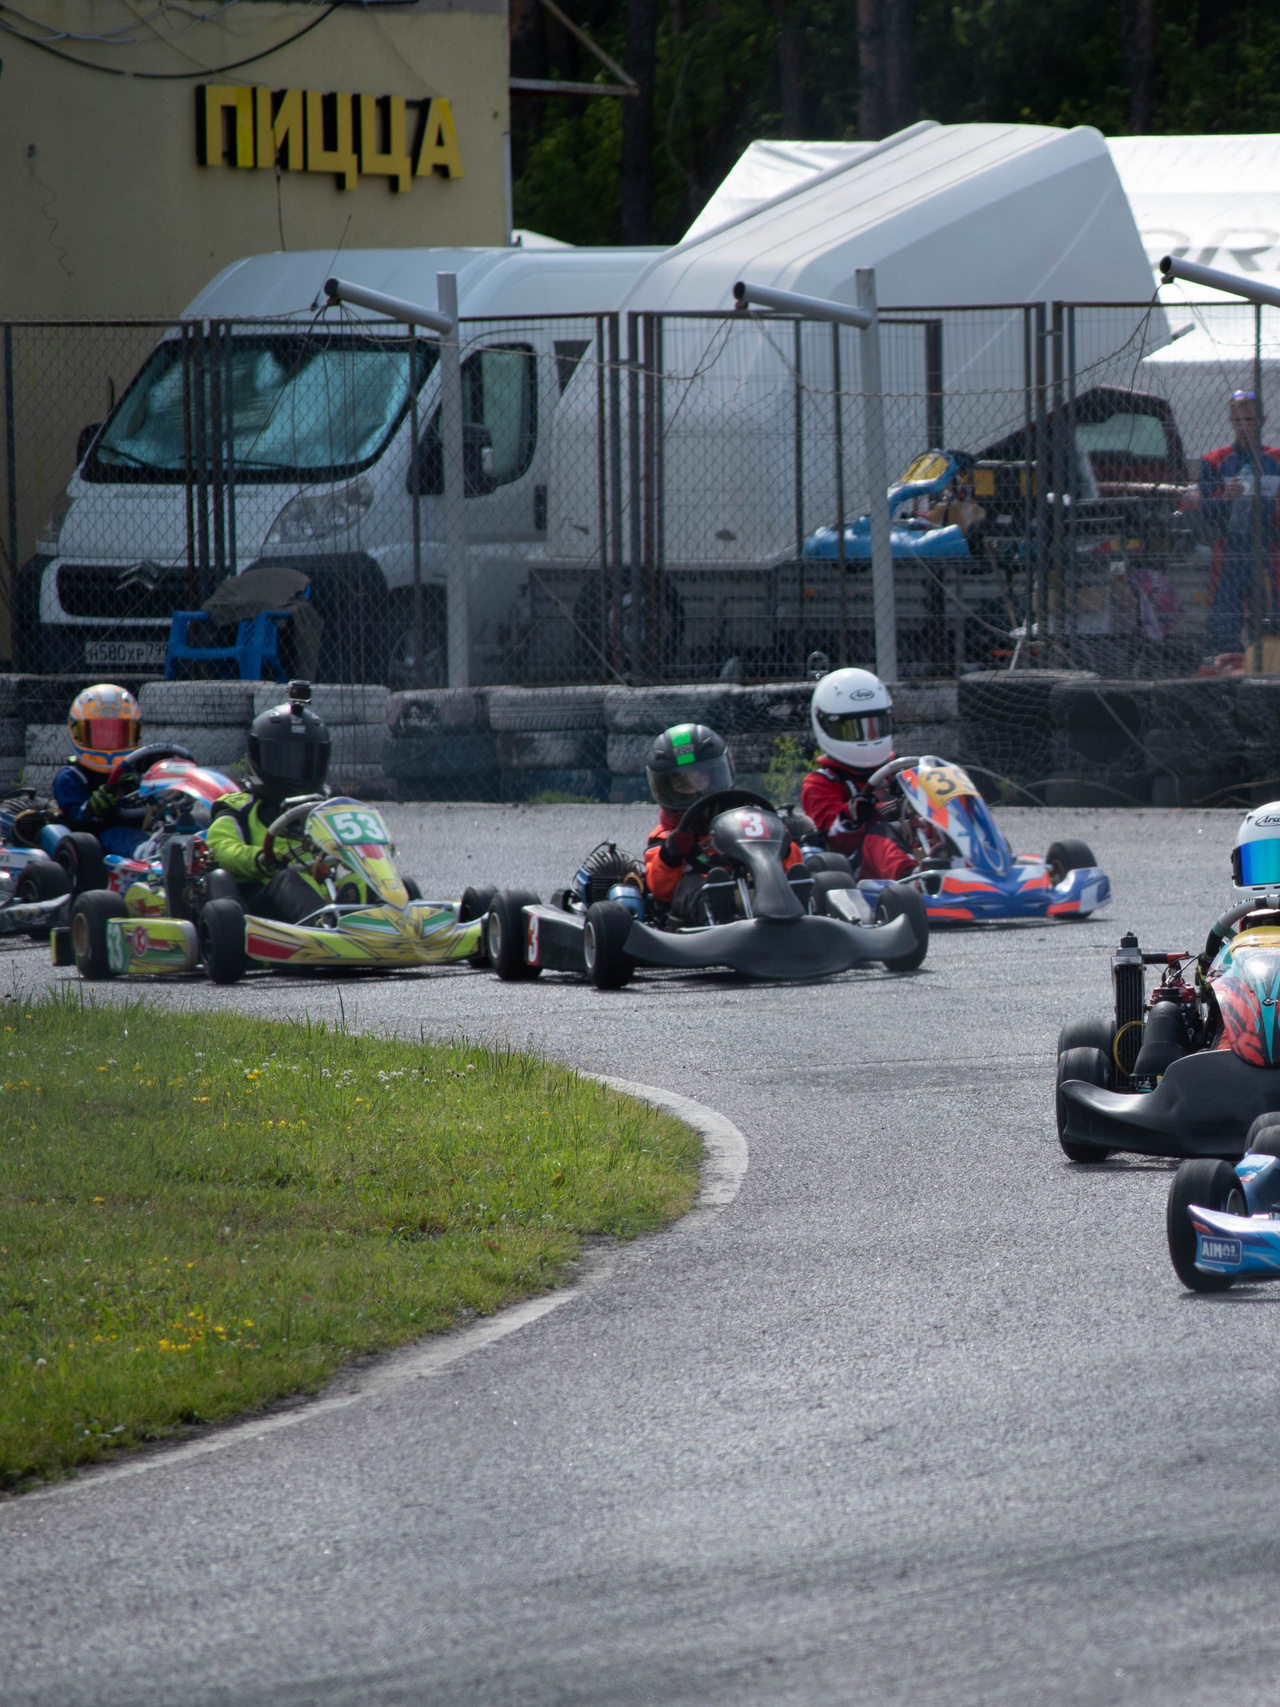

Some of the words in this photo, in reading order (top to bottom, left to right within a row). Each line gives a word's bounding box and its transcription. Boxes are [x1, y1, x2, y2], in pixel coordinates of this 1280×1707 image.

[197, 84, 465, 192] ПИЦЦА
[333, 812, 385, 840] 53
[744, 812, 764, 837] 3
[528, 915, 539, 963] 3
[1202, 1240, 1239, 1259] AIMOL
